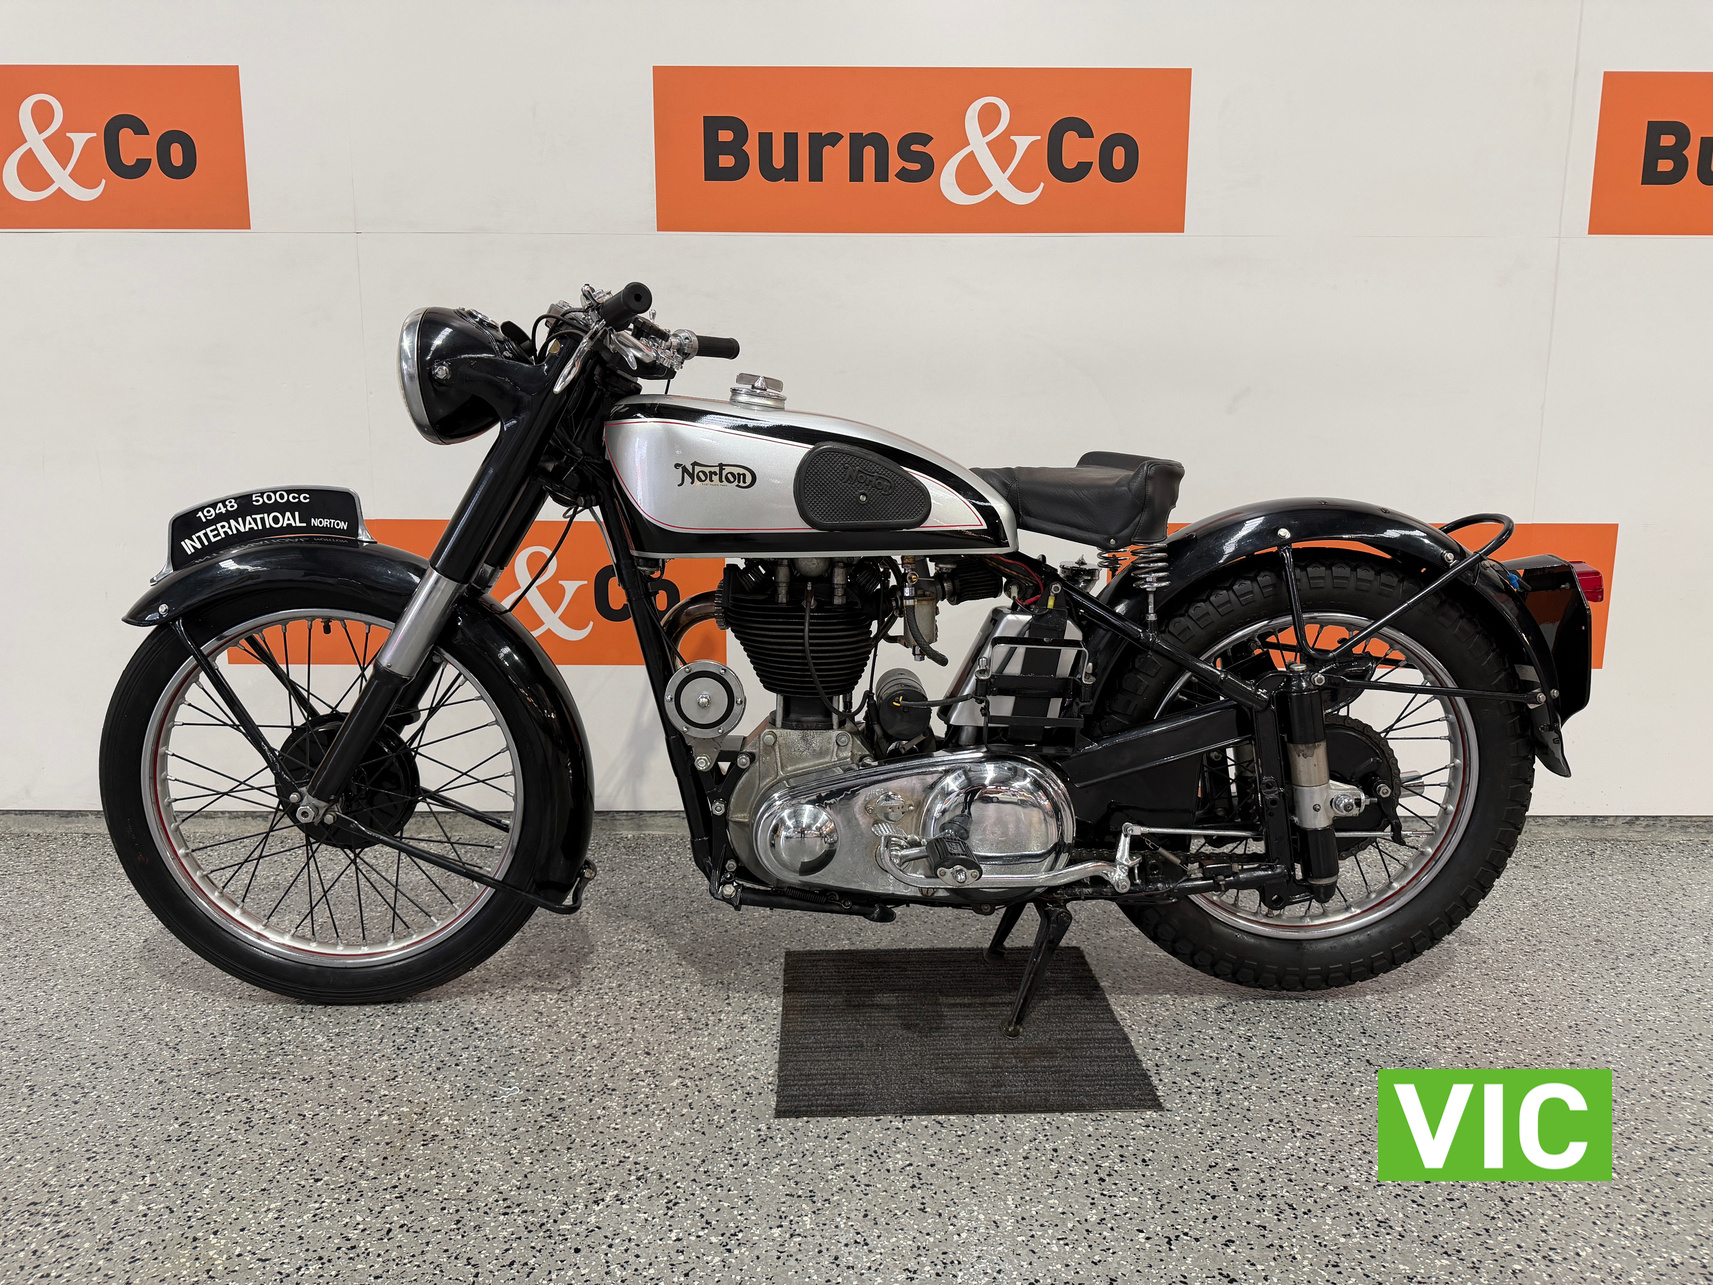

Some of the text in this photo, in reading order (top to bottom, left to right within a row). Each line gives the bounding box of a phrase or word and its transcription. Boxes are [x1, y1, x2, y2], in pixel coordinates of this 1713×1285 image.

[673, 460, 757, 490] Norton
[841, 462, 896, 496] Norton
[195, 490, 310, 523] 1948 500cc
[180, 511, 348, 555] INTERNATIOAL NORTON
